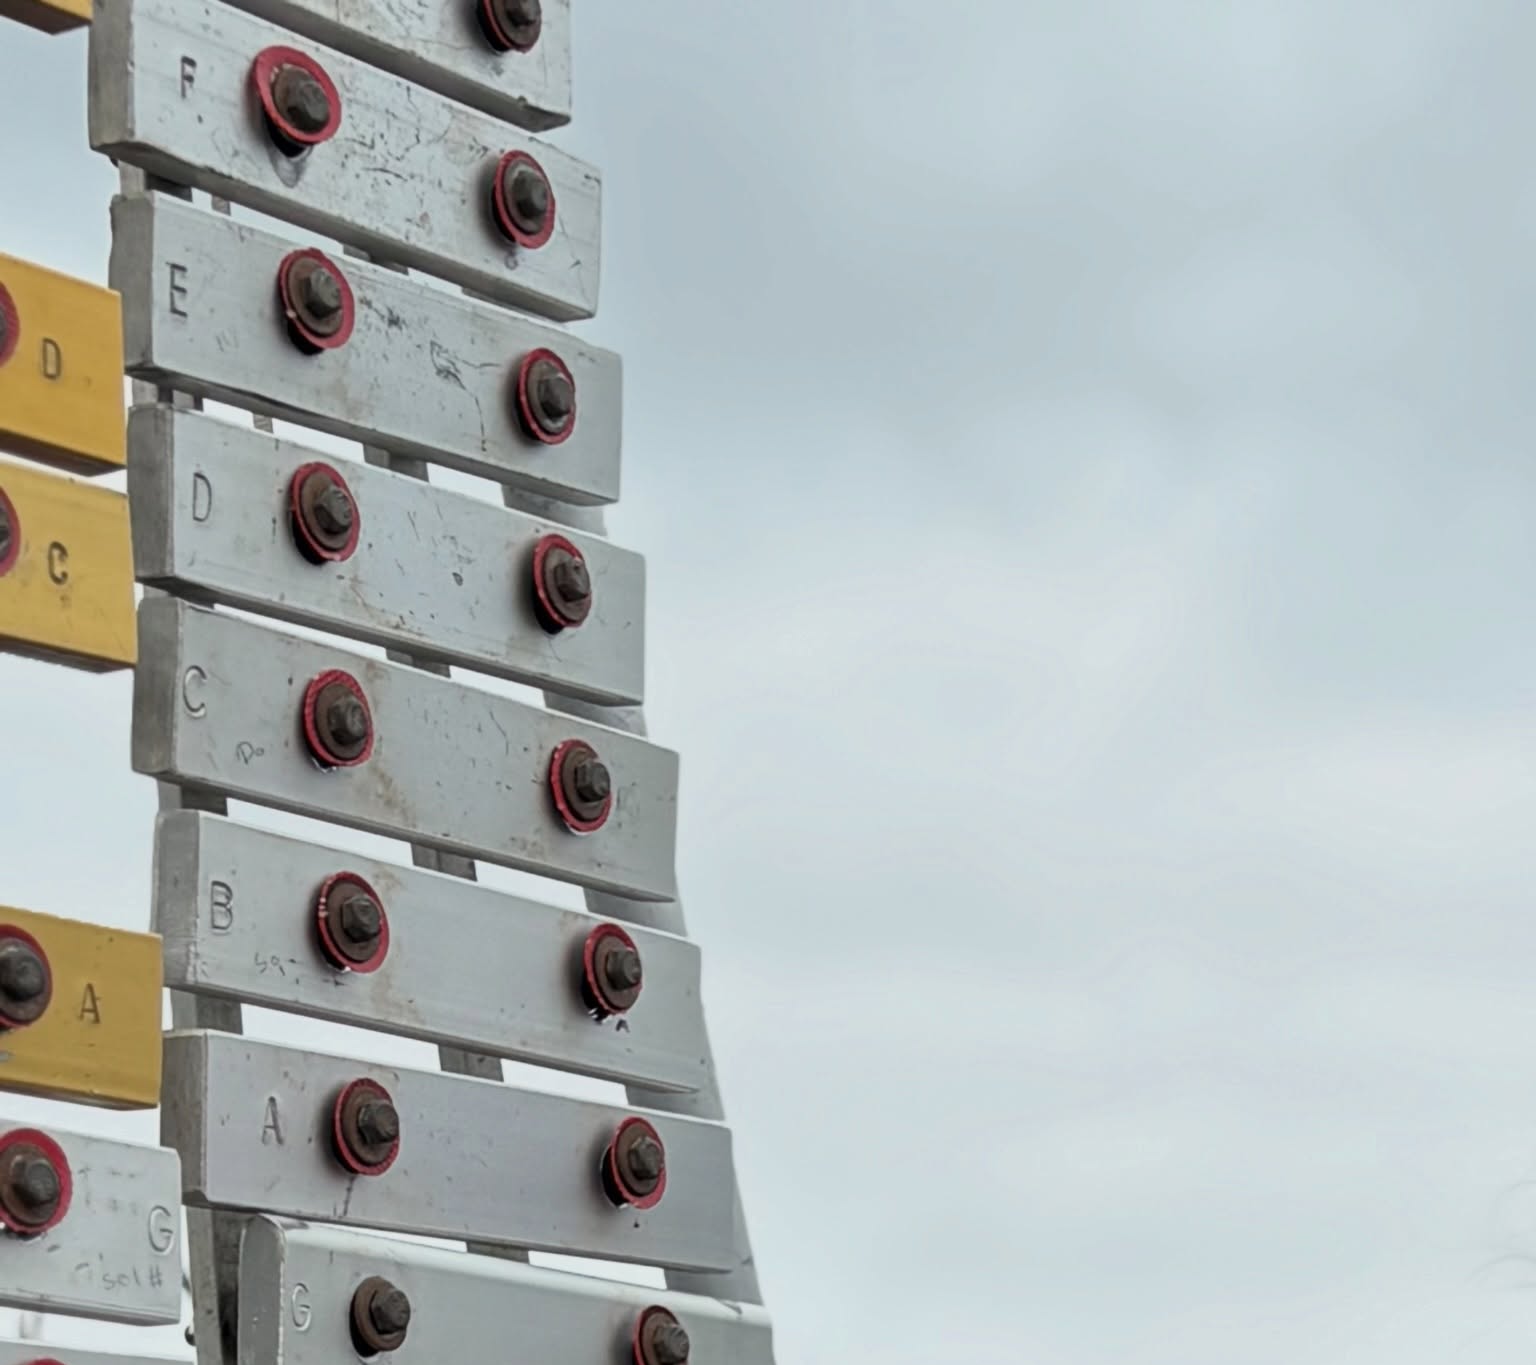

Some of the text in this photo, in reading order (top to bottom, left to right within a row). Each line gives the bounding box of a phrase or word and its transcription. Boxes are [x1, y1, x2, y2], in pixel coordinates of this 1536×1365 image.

[180, 55, 198, 100] F
[166, 261, 189, 319] E
[42, 337, 62, 381] D
[191, 471, 213, 523] D
[46, 540, 69, 586] C
[182, 664, 207, 718] C
[209, 880, 234, 934] B
[78, 982, 101, 1026] A
[261, 1096, 284, 1146] A
[147, 1204, 175, 1256] G
[291, 1282, 312, 1332] G
